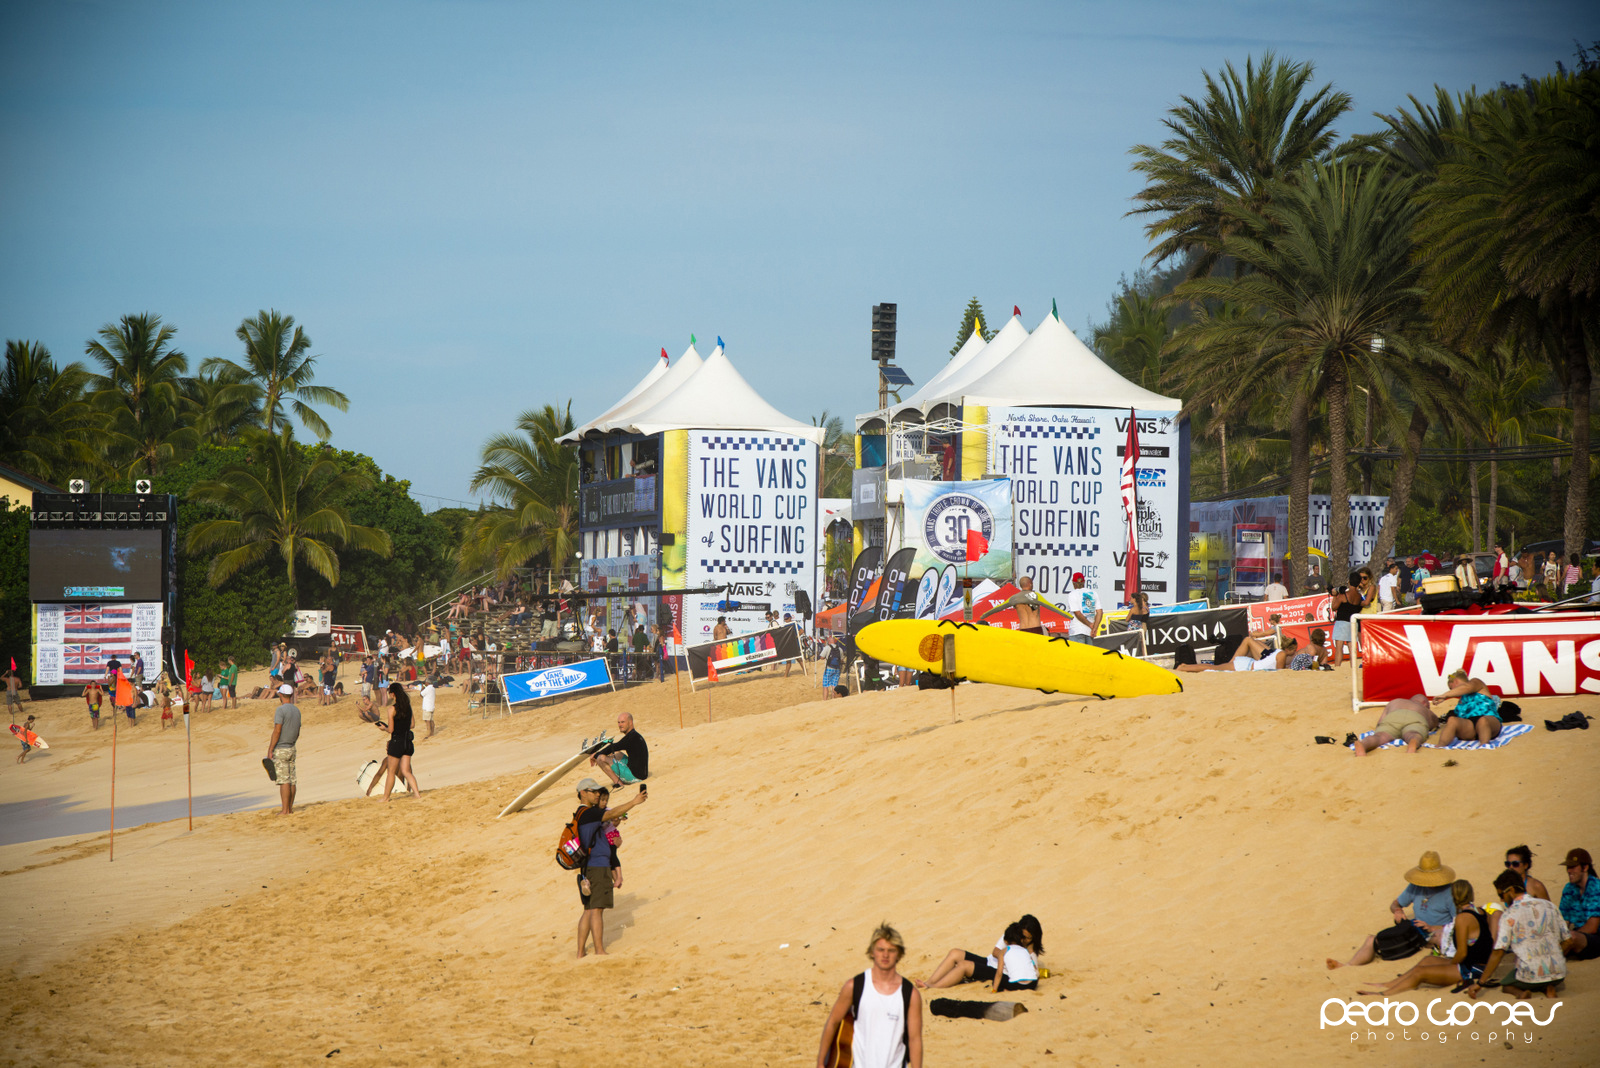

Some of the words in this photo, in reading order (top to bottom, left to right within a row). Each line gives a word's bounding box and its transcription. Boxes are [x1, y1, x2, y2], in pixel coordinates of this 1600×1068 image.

[1115, 417, 1157, 434] VNS
[911, 440, 922, 449] VAN
[1000, 445, 1038, 474] THE
[1053, 446, 1102, 476] VANS
[700, 457, 740, 488] THE
[756, 458, 807, 489] VANS
[1011, 480, 1058, 504] ORLD
[1071, 480, 1102, 504] CUP
[700, 494, 762, 518] WORLD
[775, 494, 807, 520] CUP
[944, 515, 970, 544] 30
[1020, 509, 1100, 538] SURFING
[1312, 514, 1329, 536] TH
[701, 531, 714, 548] of
[720, 525, 804, 554] SURFING
[1113, 551, 1154, 568] VNS
[727, 582, 764, 596] VANS
[1026, 565, 1072, 594] 2012
[880, 568, 898, 621] oPro
[1284, 604, 1306, 612] Sponsor
[1146, 624, 1208, 646] IXON
[544, 670, 564, 680] VANS
[548, 678, 564, 687] THE
